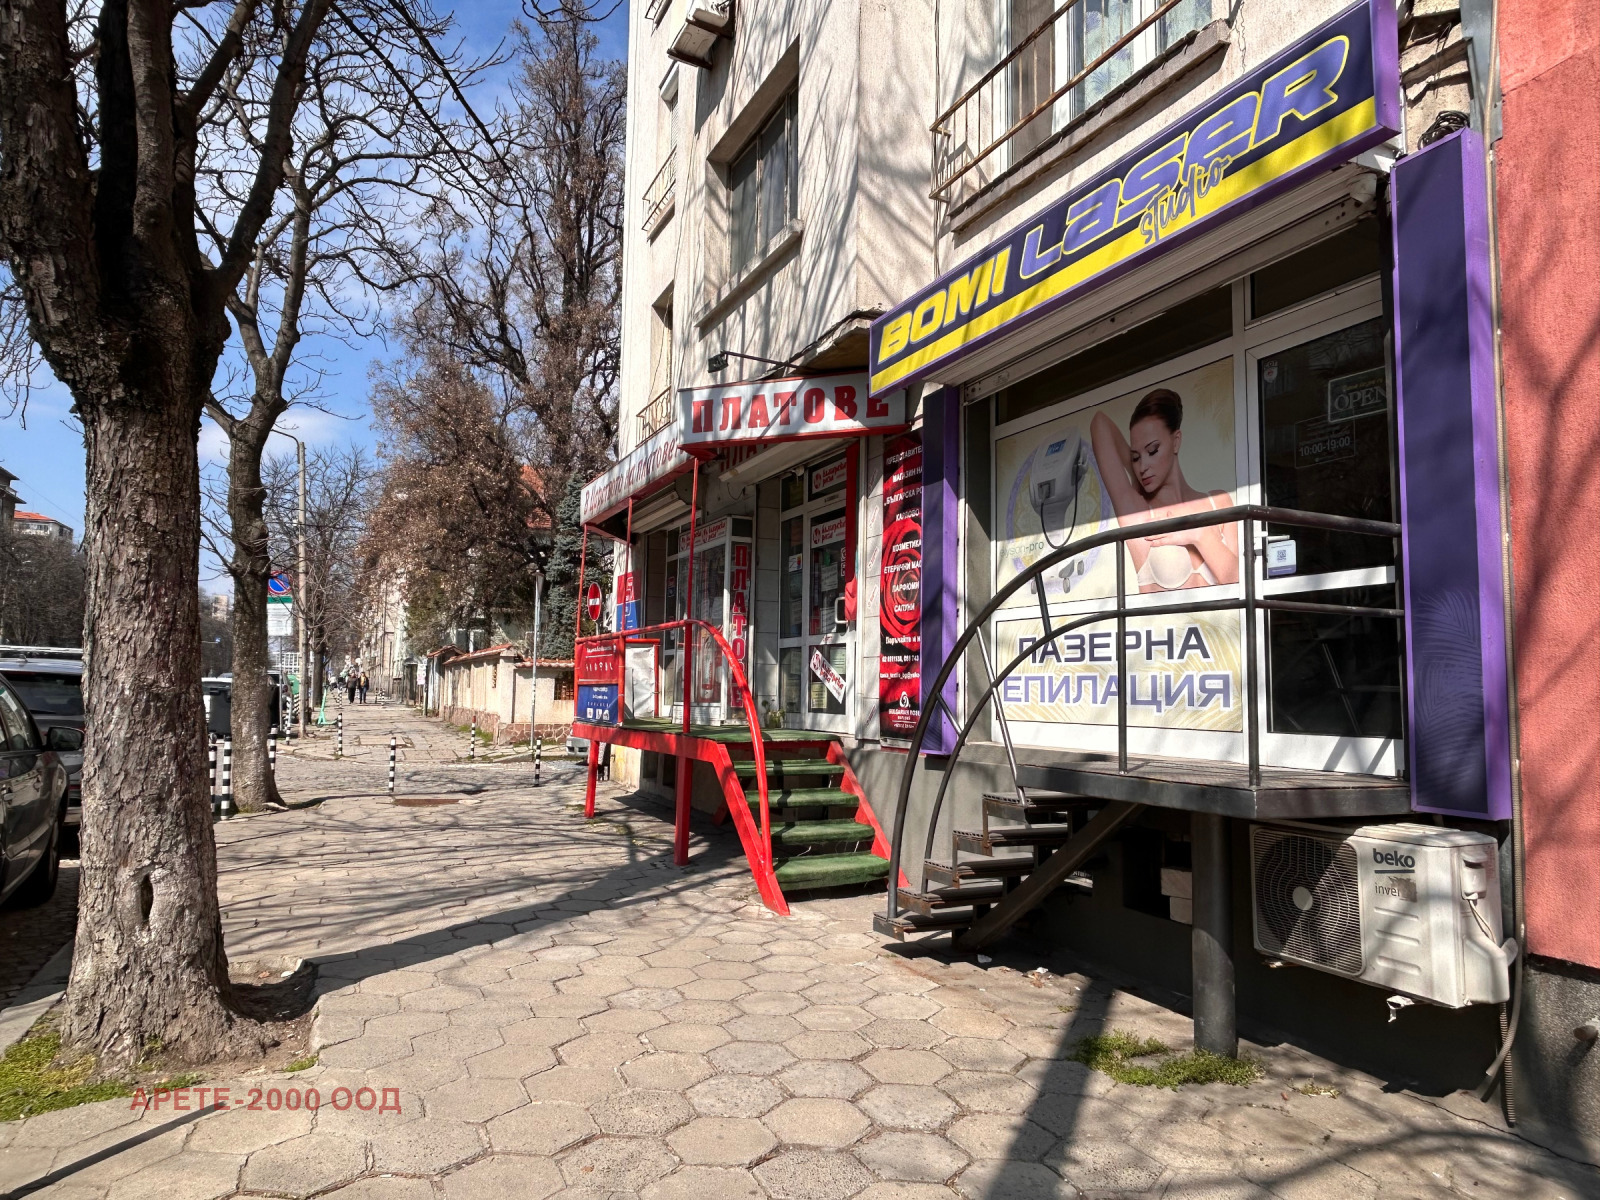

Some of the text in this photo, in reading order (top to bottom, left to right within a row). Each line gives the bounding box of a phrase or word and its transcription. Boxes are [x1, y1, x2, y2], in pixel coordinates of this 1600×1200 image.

[877, 244, 1012, 364] BOMI
[691, 385, 889, 434] ПЛАТОВЕ
[886, 445, 922, 465] ПРЕДСТАВИТЕ
[1299, 436, 1351, 457] 10:00-19:00
[1003, 673, 1230, 714] ЕПИЛАЦИЯ
[1373, 848, 1415, 868] beko
